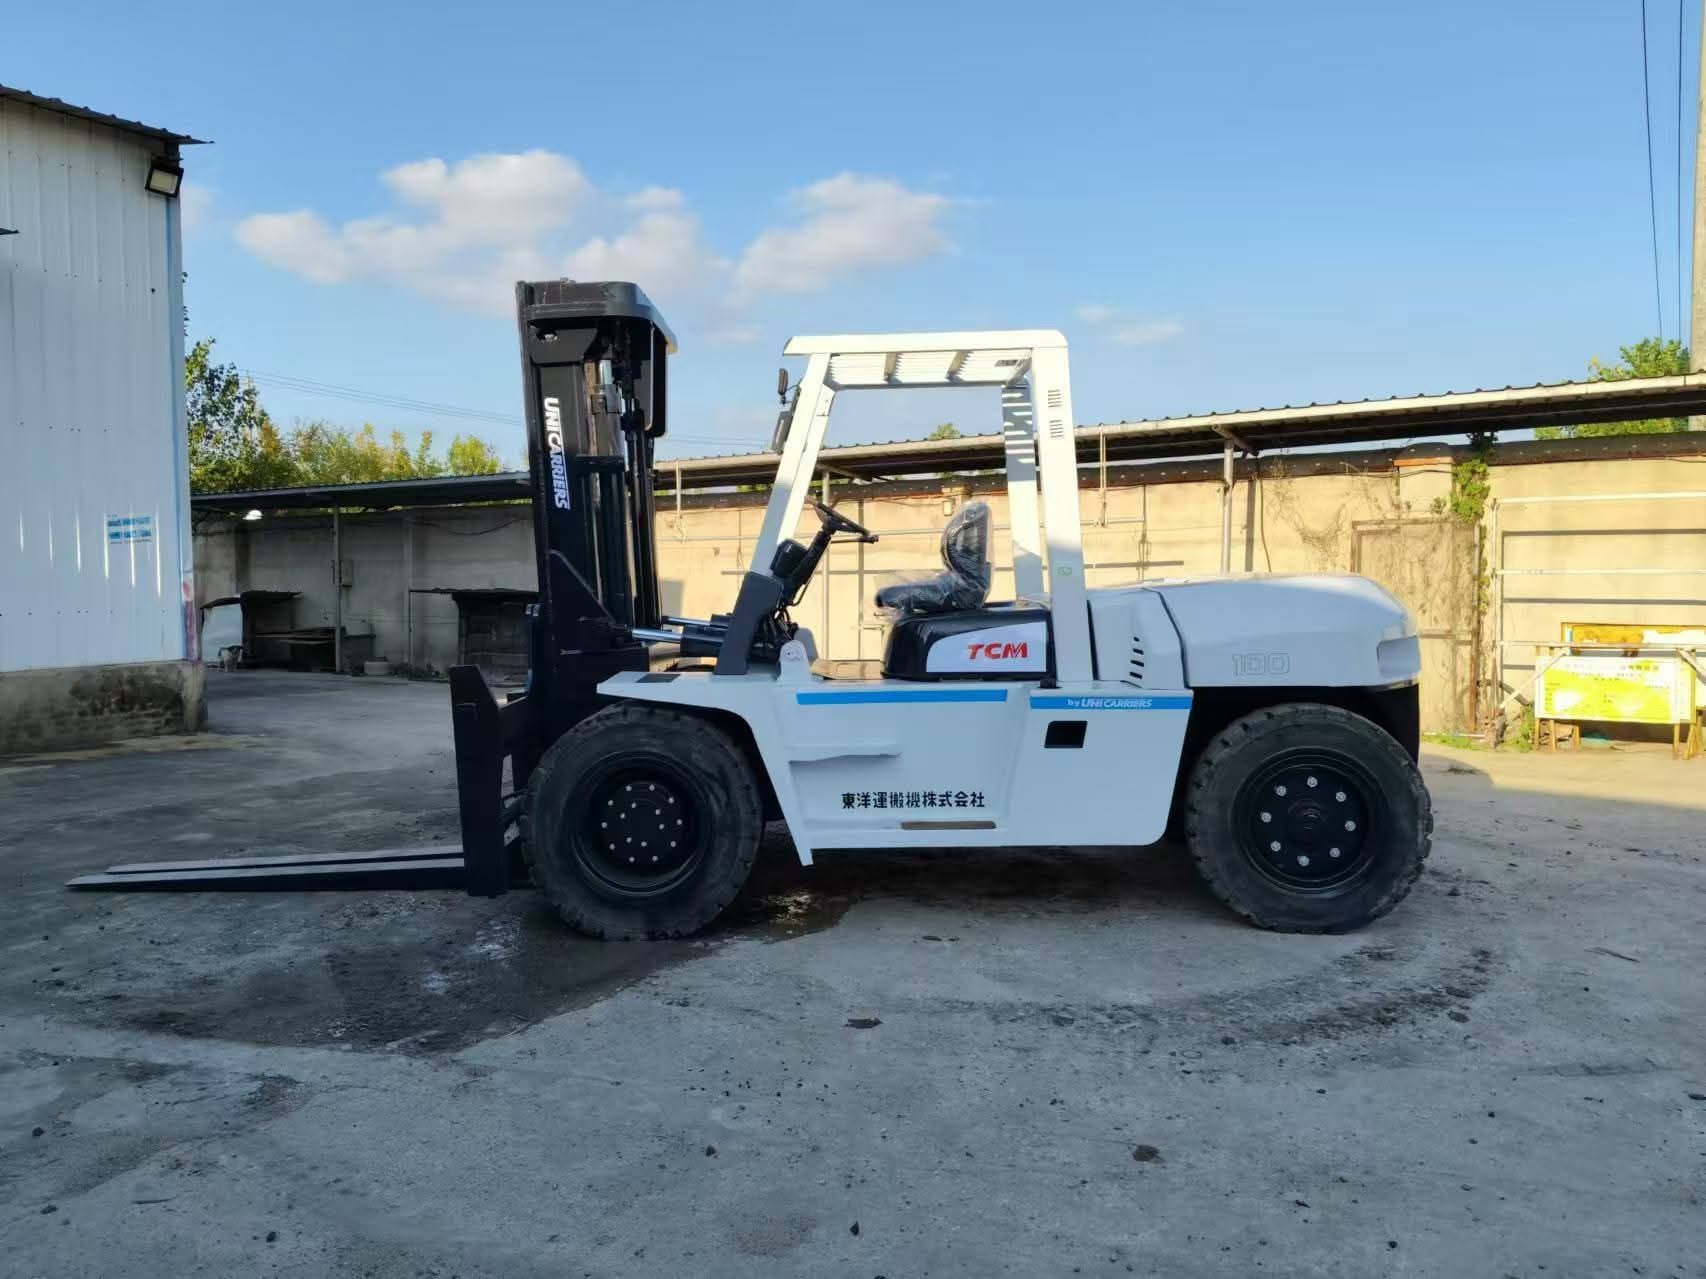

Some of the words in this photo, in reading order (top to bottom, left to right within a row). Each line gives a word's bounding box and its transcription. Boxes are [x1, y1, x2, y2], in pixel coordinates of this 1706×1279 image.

[544, 397, 570, 510] UNICARRIERS
[968, 642, 1028, 659] TCM
[1232, 653, 1290, 676] 100
[1067, 698, 1080, 708] by
[841, 791, 985, 809] 東洋運搬機株式会社
